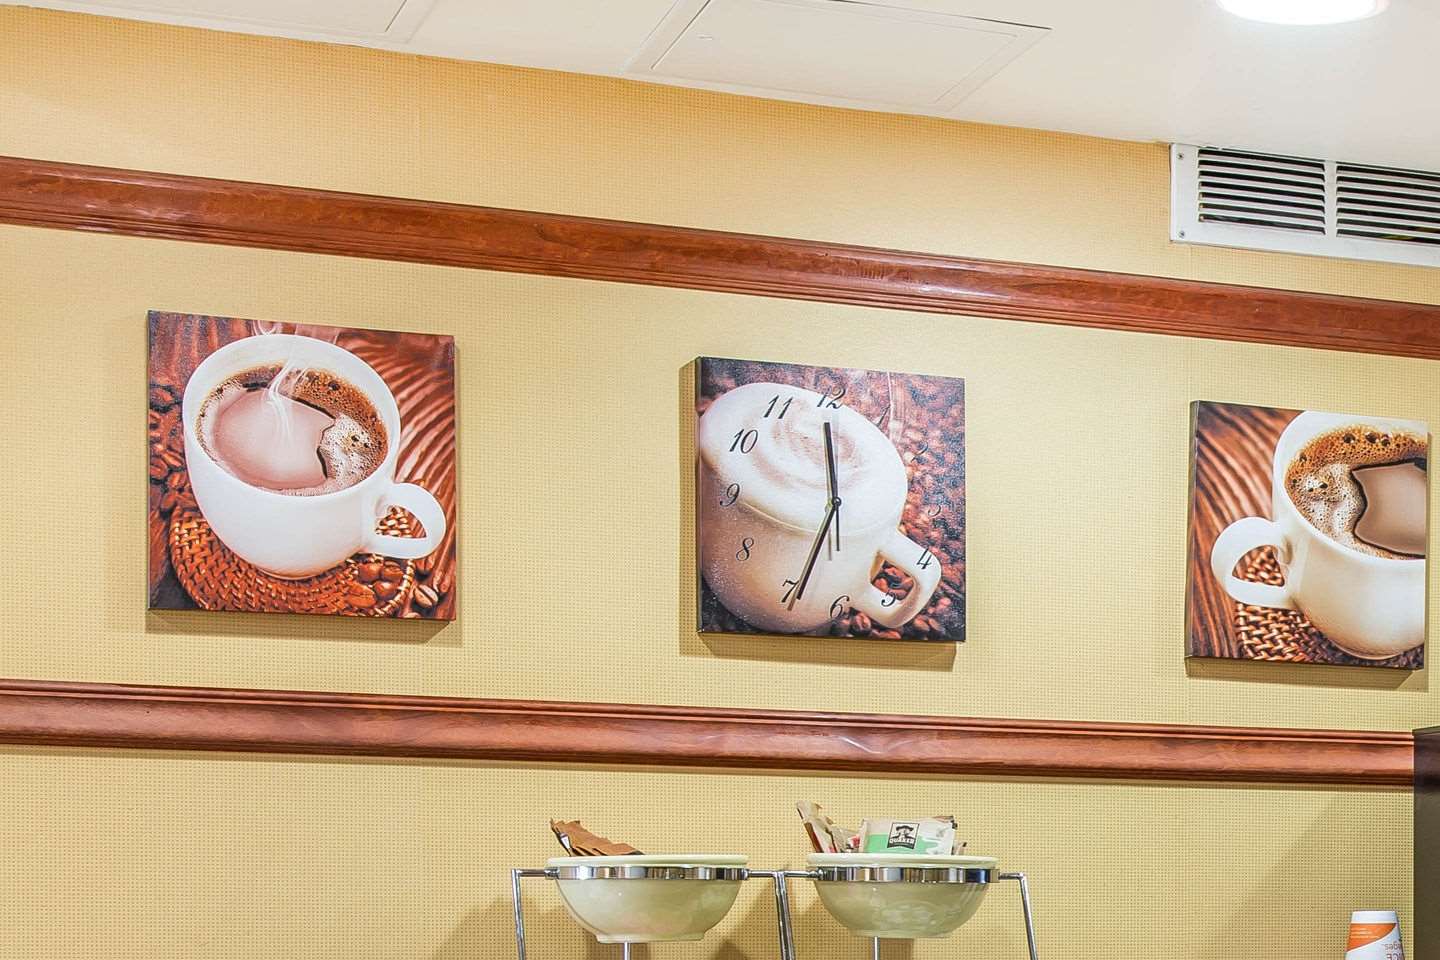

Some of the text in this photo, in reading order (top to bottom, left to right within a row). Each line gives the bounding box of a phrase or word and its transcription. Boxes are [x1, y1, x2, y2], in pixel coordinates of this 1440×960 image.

[763, 395, 794, 420] 11
[817, 387, 846, 409] 12
[729, 429, 759, 454] 10
[719, 482, 740, 508] 9
[735, 537, 754, 562] 8
[915, 548, 932, 570] 4
[781, 577, 801, 603] 7
[829, 595, 850, 620] 6
